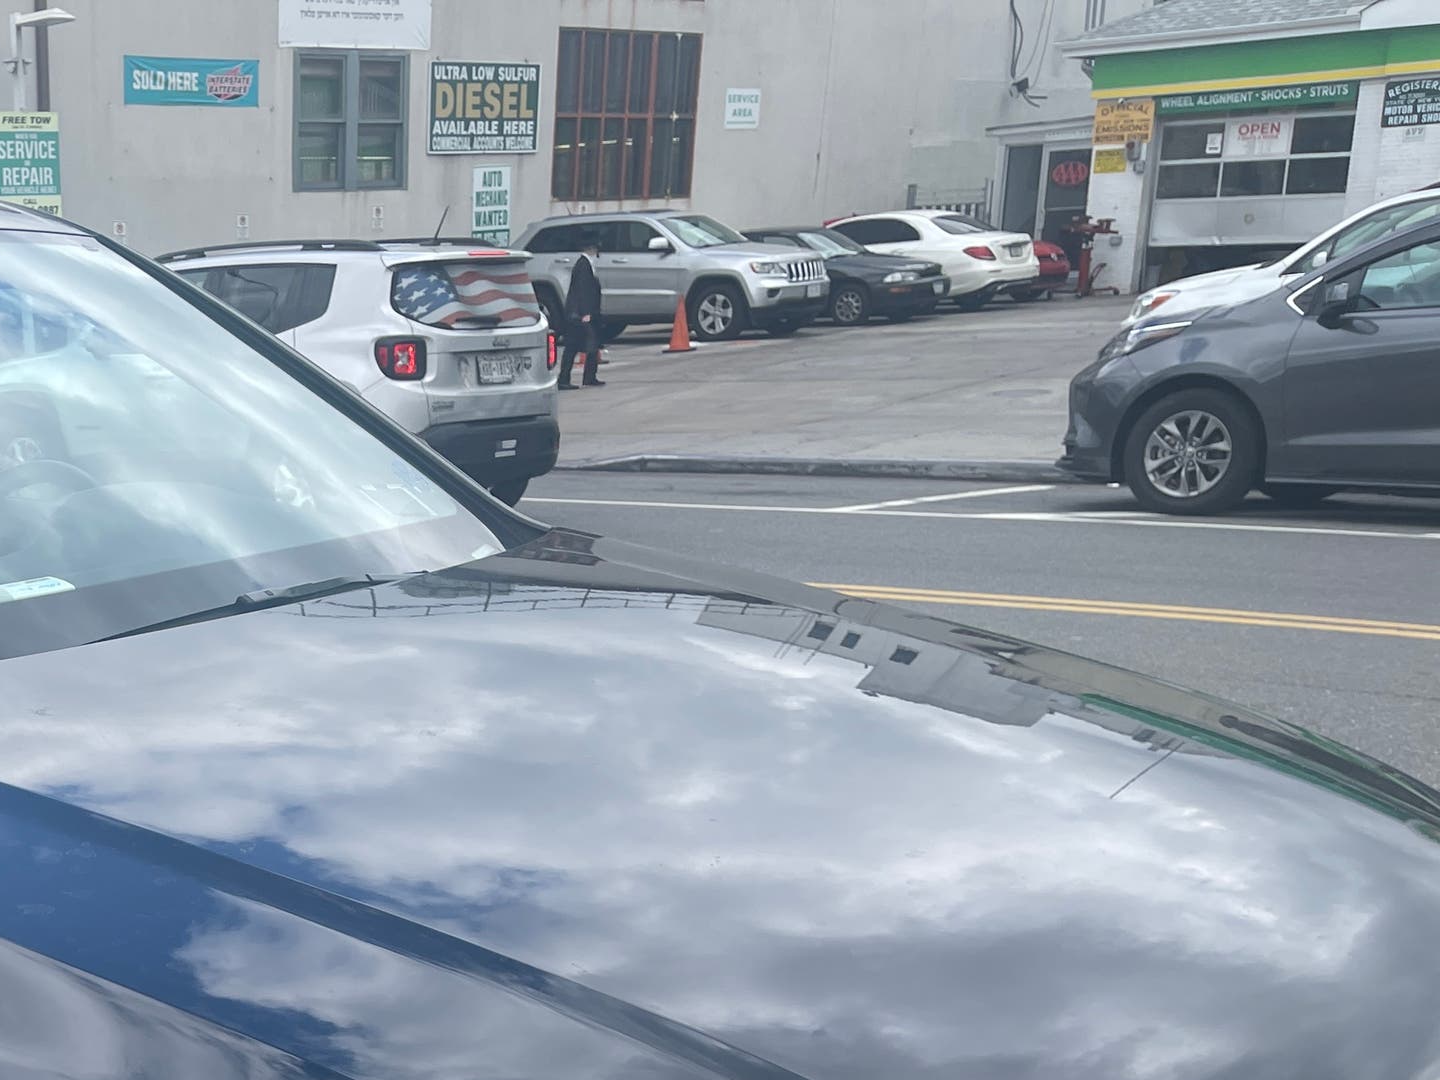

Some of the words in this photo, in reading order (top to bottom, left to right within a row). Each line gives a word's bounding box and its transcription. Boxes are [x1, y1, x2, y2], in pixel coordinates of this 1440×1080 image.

[132, 69, 165, 90] SOLD
[167, 71, 199, 91] HERE
[207, 75, 251, 85] INTERSTATE
[434, 65, 468, 80] ULTRA
[472, 66, 495, 80] LOW
[498, 67, 537, 81] SULFUR
[208, 85, 248, 94] BATTERIES
[1161, 95, 1194, 108] WHEEL
[1197, 91, 1253, 105] ALIGNMENT
[1261, 87, 1302, 101] SHOCKS
[1310, 84, 1349, 97] STRUTS
[435, 82, 534, 119] DIESEL
[728, 94, 759, 104] SERVICE
[732, 108, 752, 117] AREA
[1384, 105, 1413, 116] MOTOR
[2, 116, 27, 124] FREE
[30, 116, 51, 124] TOW
[1388, 114, 1418, 126] REPAIR
[1421, 112, 1440, 123] SHO
[432, 120, 499, 135] AVAILABLE
[503, 121, 534, 135] HERE
[1238, 122, 1280, 136] OPEN
[432, 136, 471, 150] COMMERCIAL
[472, 136, 504, 150] ACCOUNTS
[505, 136, 533, 150] WELCOME
[2, 167, 53, 186] REPAIR
[482, 170, 503, 187] AUTO
[475, 189, 508, 207] MECHANIC
[474, 209, 508, 227] WANTED
